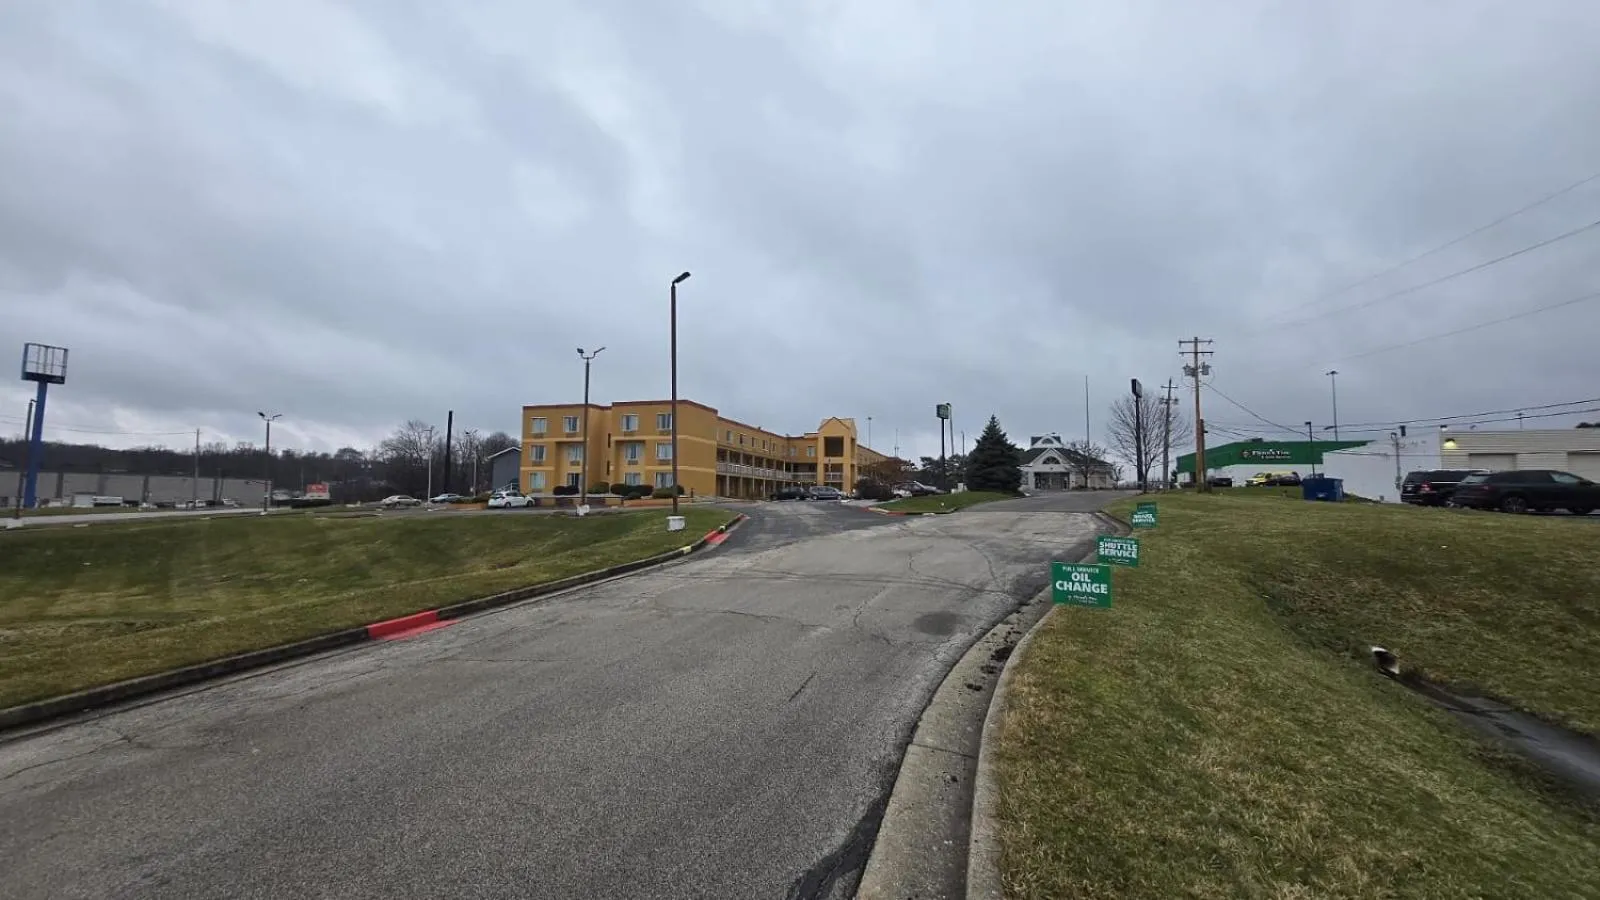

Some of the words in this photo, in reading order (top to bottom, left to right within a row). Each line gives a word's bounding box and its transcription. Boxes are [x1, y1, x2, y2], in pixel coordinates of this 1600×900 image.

[1099, 541, 1138, 551] SHUTTLE
[1099, 548, 1138, 559] SERVICE
[1071, 572, 1091, 582] OIL
[1055, 580, 1108, 594] CHANGE
